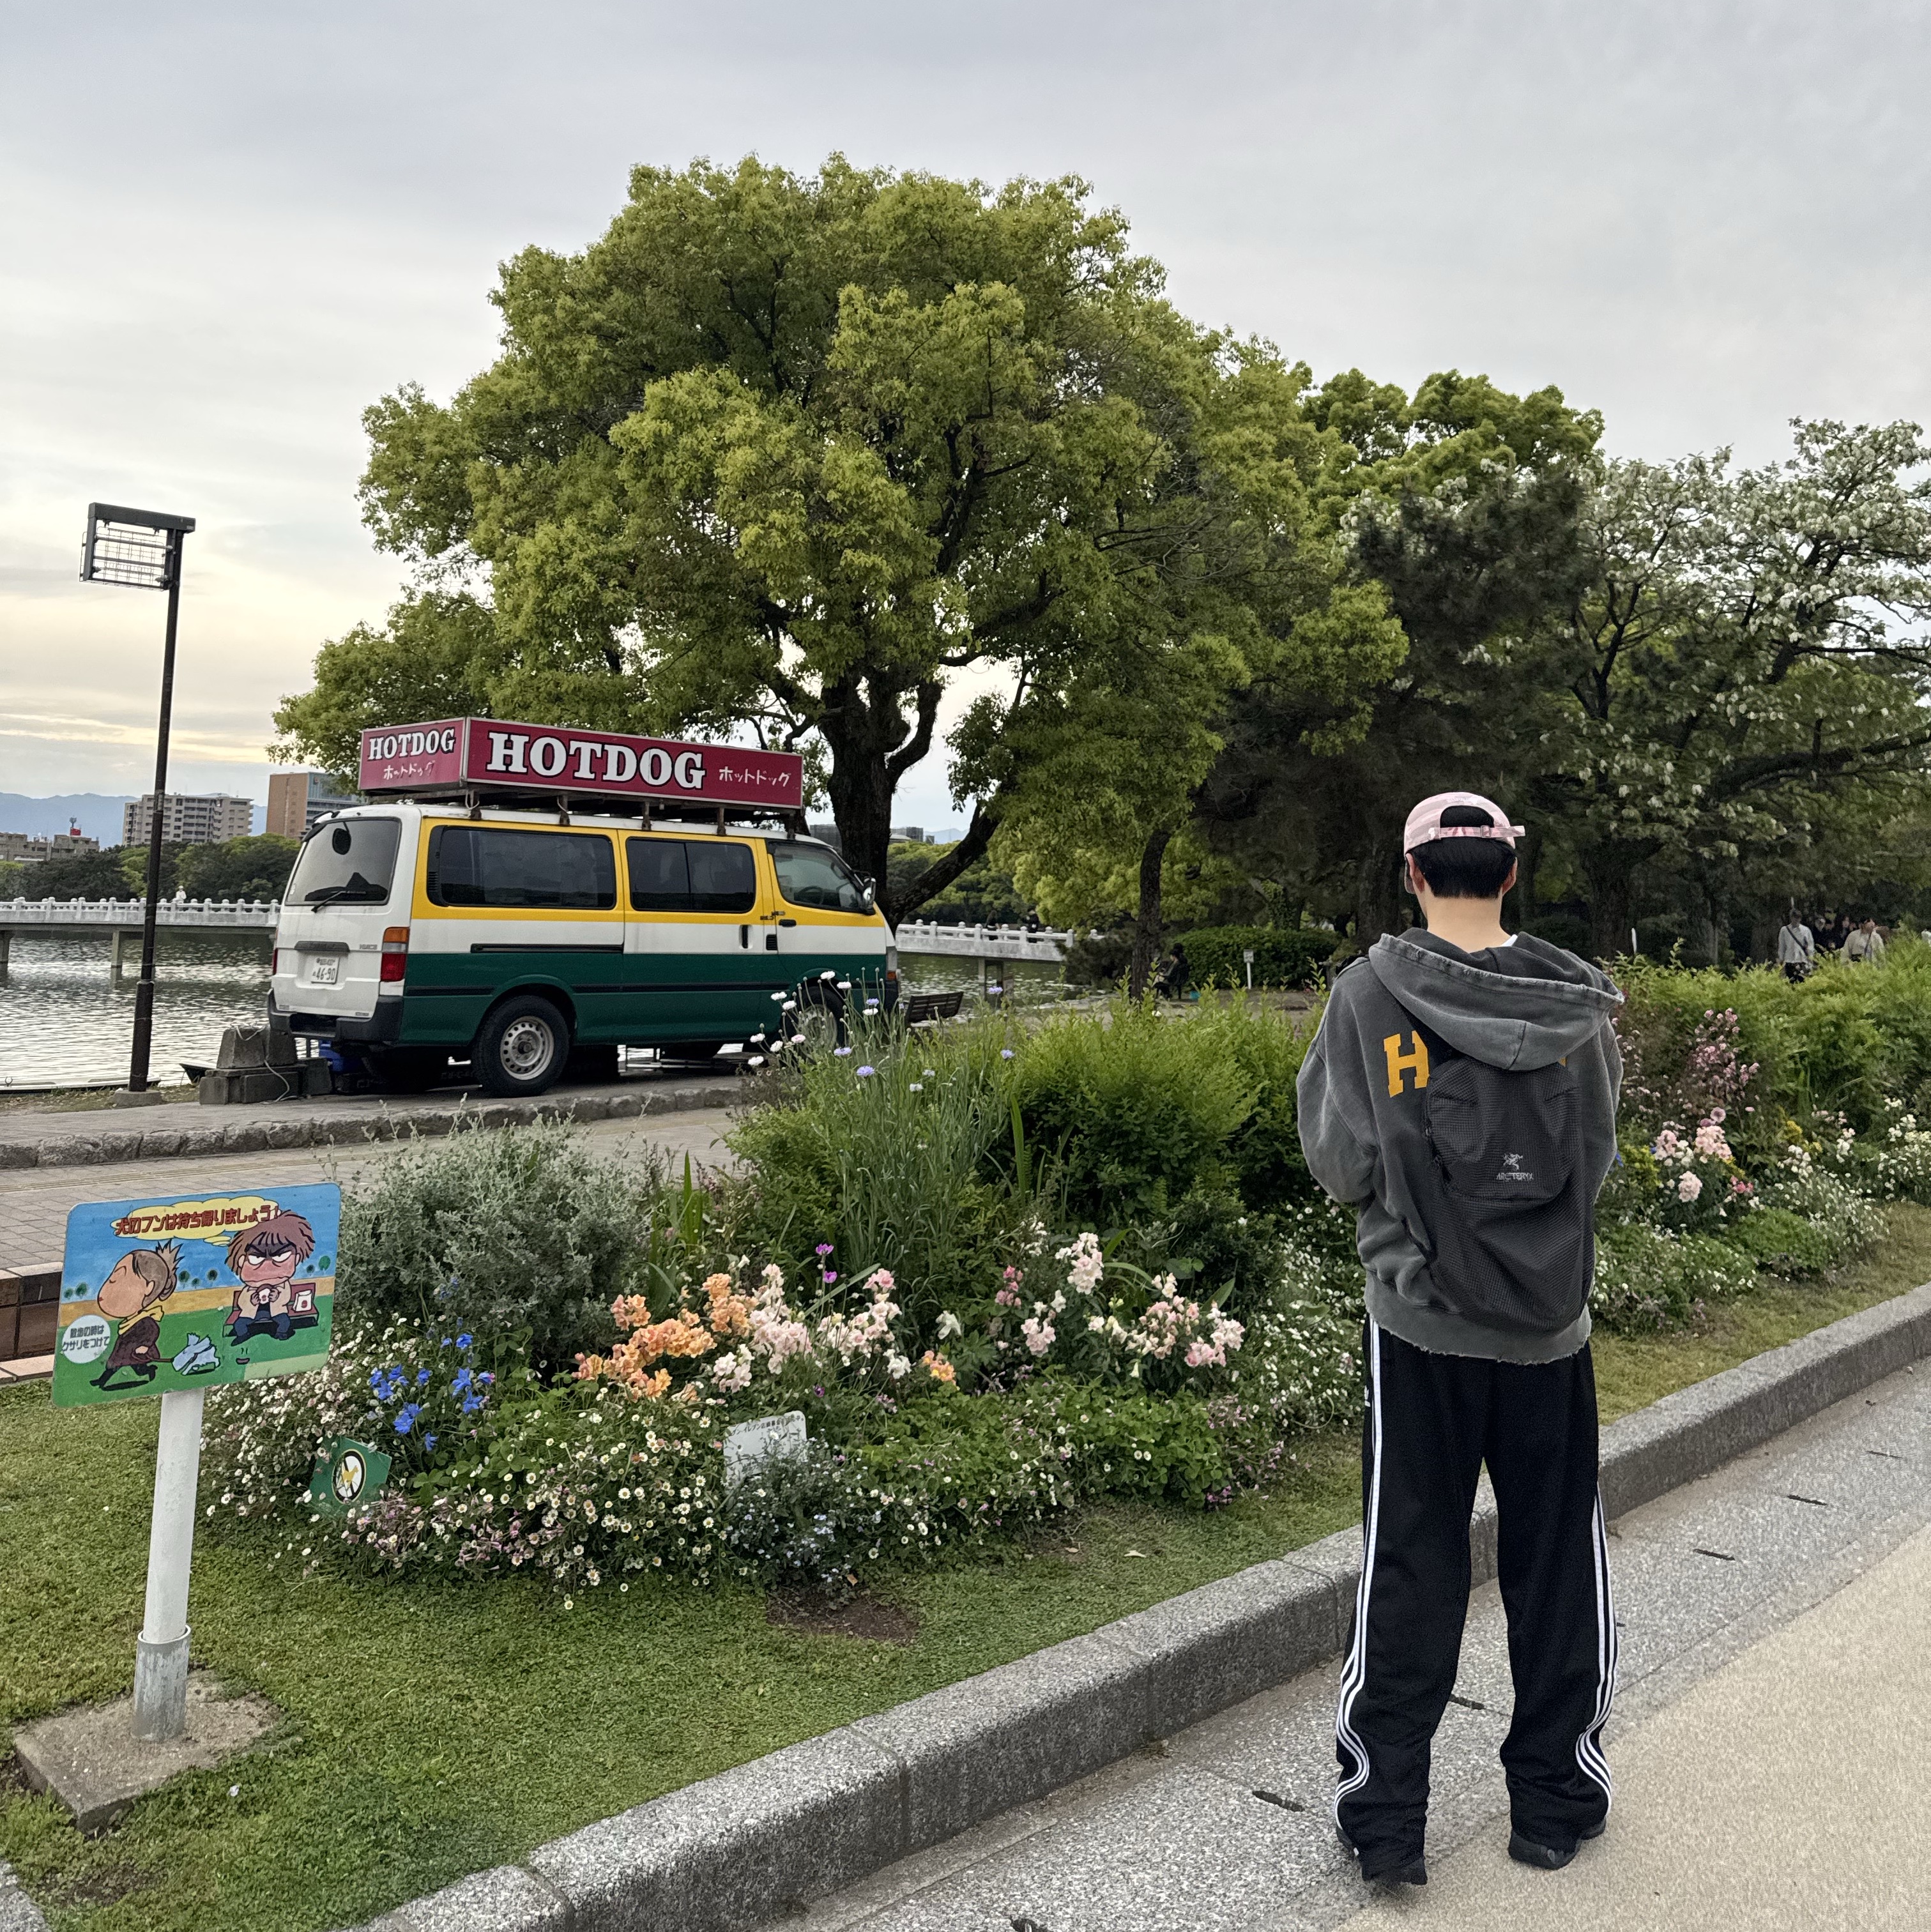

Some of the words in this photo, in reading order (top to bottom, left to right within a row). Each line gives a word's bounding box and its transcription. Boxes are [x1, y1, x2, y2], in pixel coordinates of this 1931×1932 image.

[368, 727, 455, 761] HOTDOG
[486, 732, 706, 789] HOTDOG
[719, 766, 791, 787] ホットドッグ
[383, 760, 436, 780] ホットドッグ
